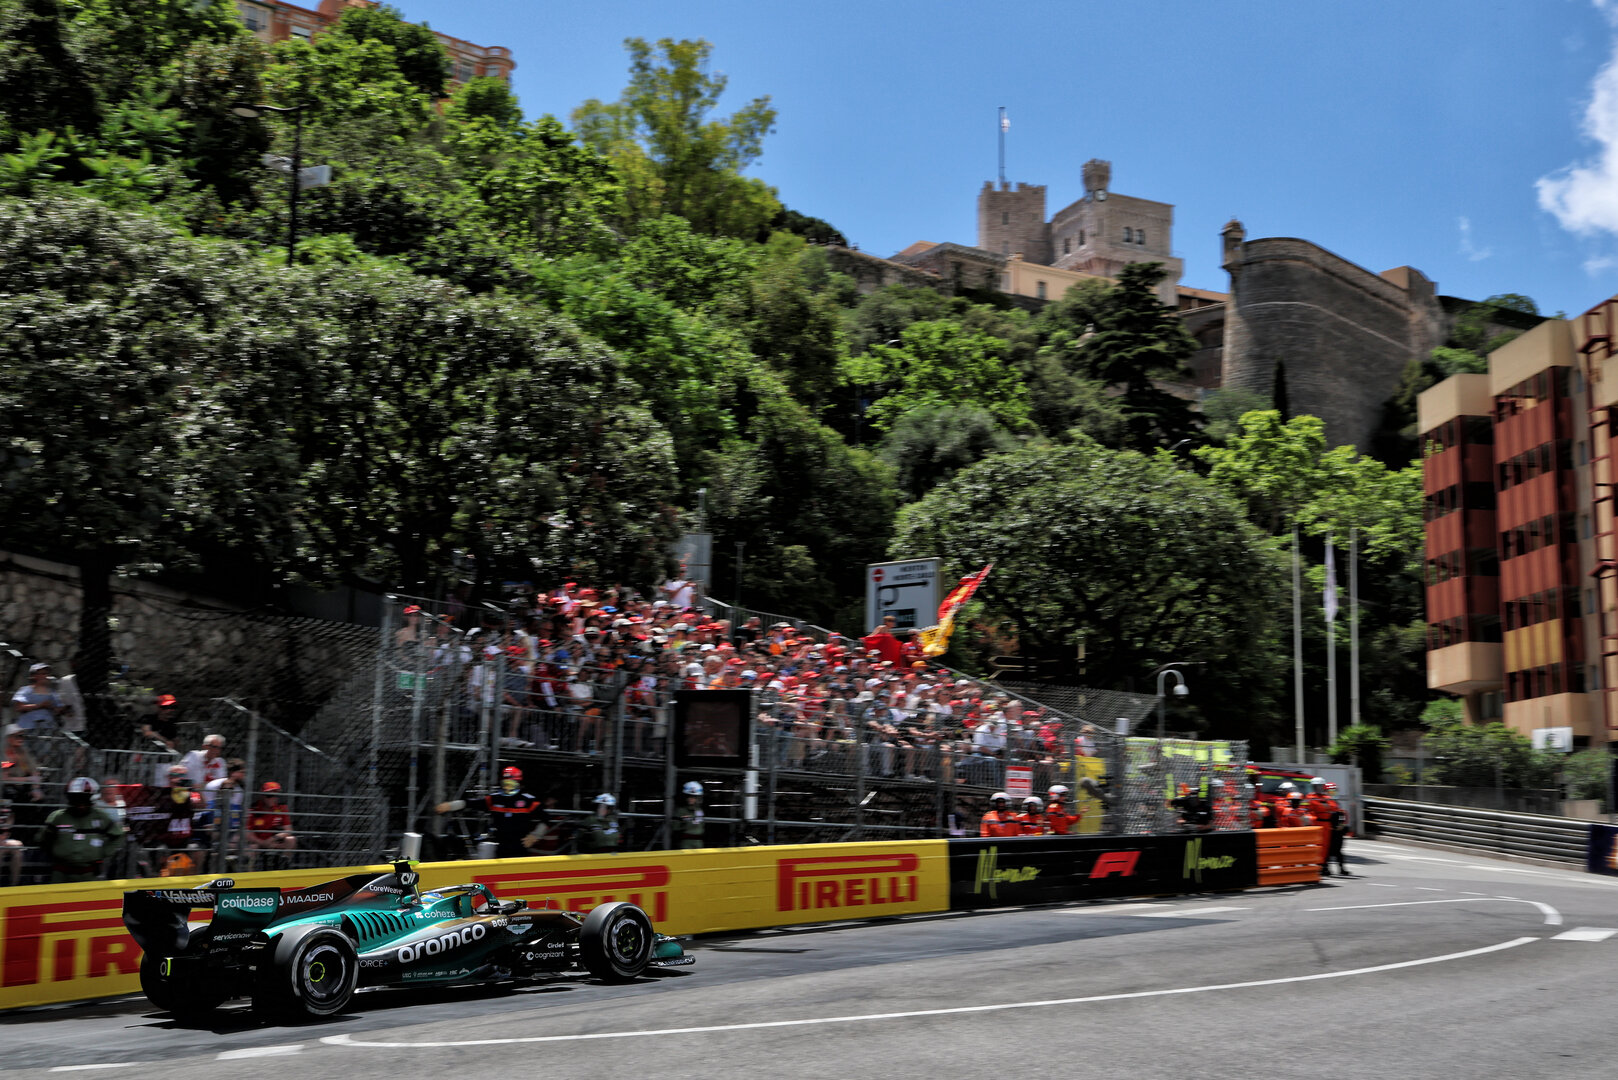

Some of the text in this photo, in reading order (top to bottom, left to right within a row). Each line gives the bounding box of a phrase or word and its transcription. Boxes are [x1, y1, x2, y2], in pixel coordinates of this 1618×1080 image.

[216, 878, 234, 887] arm
[777, 853, 920, 911] PIRELLI
[369, 884, 403, 895] CoreWeave
[163, 890, 216, 903] Valvolin
[286, 893, 334, 904] MAADEN
[221, 895, 275, 909] coinbase
[424, 910, 456, 918] cohere
[491, 919, 508, 928] BOSS
[213, 933, 252, 941] servicenow
[398, 924, 486, 963] aramco
[534, 951, 565, 960] cognizant
[358, 960, 388, 968] ORCE+
